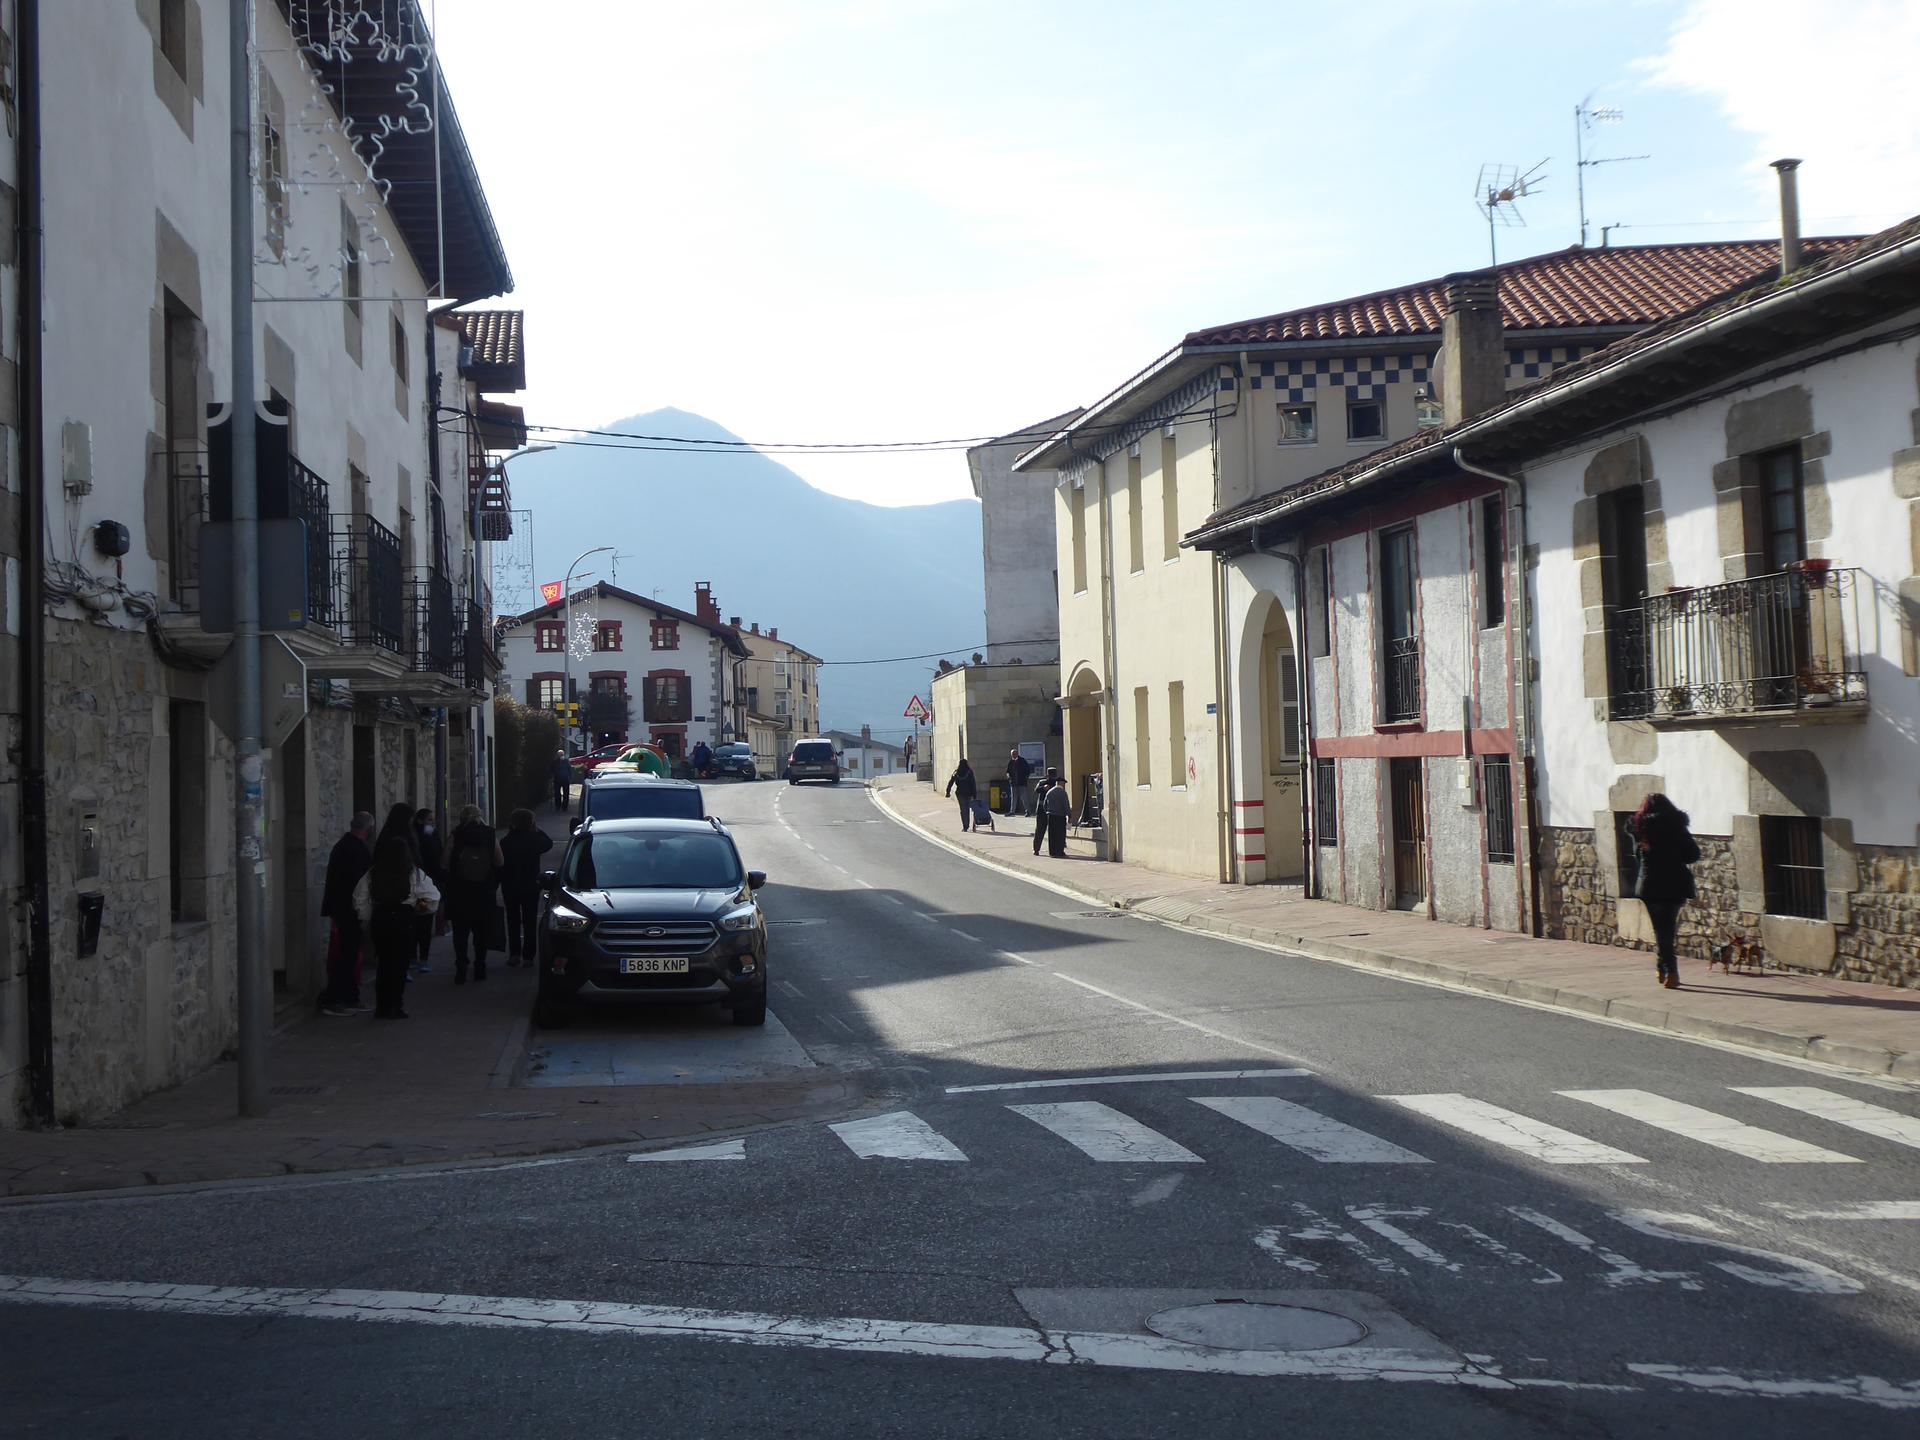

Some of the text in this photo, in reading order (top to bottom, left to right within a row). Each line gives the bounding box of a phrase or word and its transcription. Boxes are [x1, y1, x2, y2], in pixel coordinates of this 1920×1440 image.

[628, 960, 686, 972] 5836 KNP
[1253, 1201, 1867, 1296] STOP
